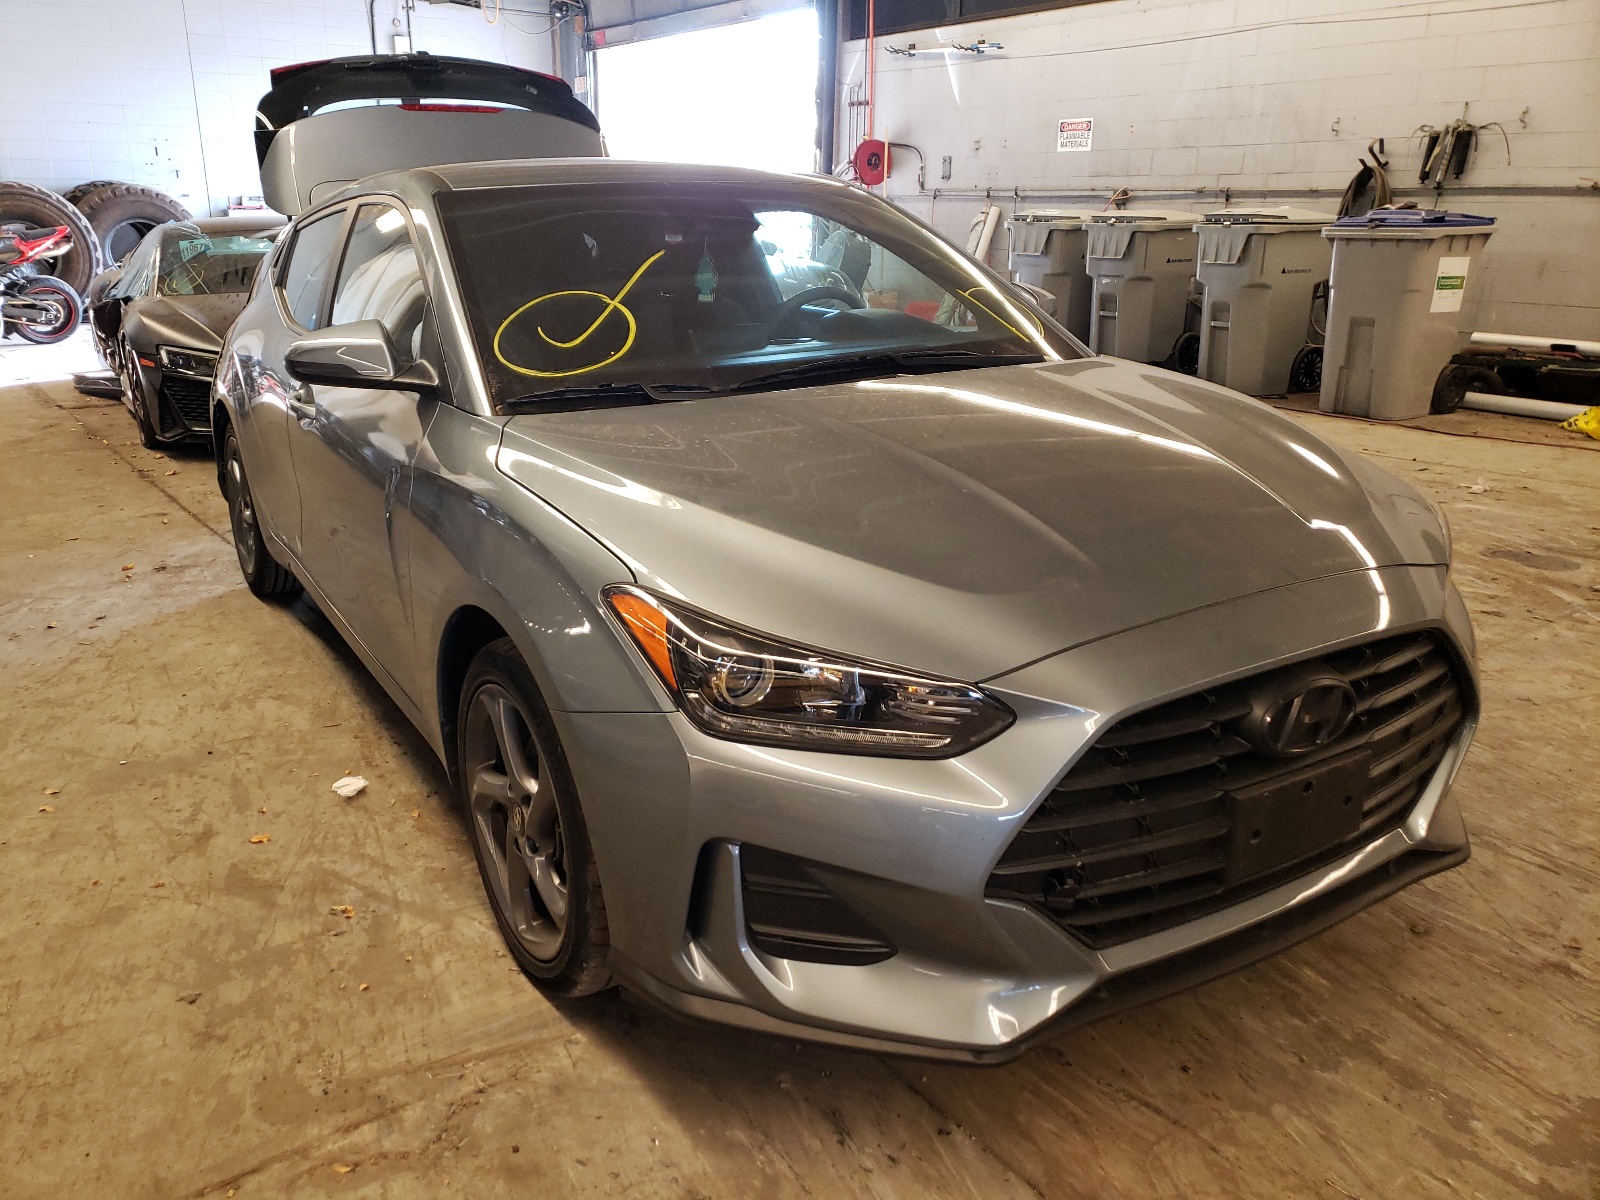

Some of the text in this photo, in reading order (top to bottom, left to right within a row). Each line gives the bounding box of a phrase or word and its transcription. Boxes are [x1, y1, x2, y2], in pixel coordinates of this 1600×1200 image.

[1059, 132, 1090, 140] FLAMMABLE
[1060, 140, 1089, 148] MATERIALS
[181, 243, 204, 260] 11967
